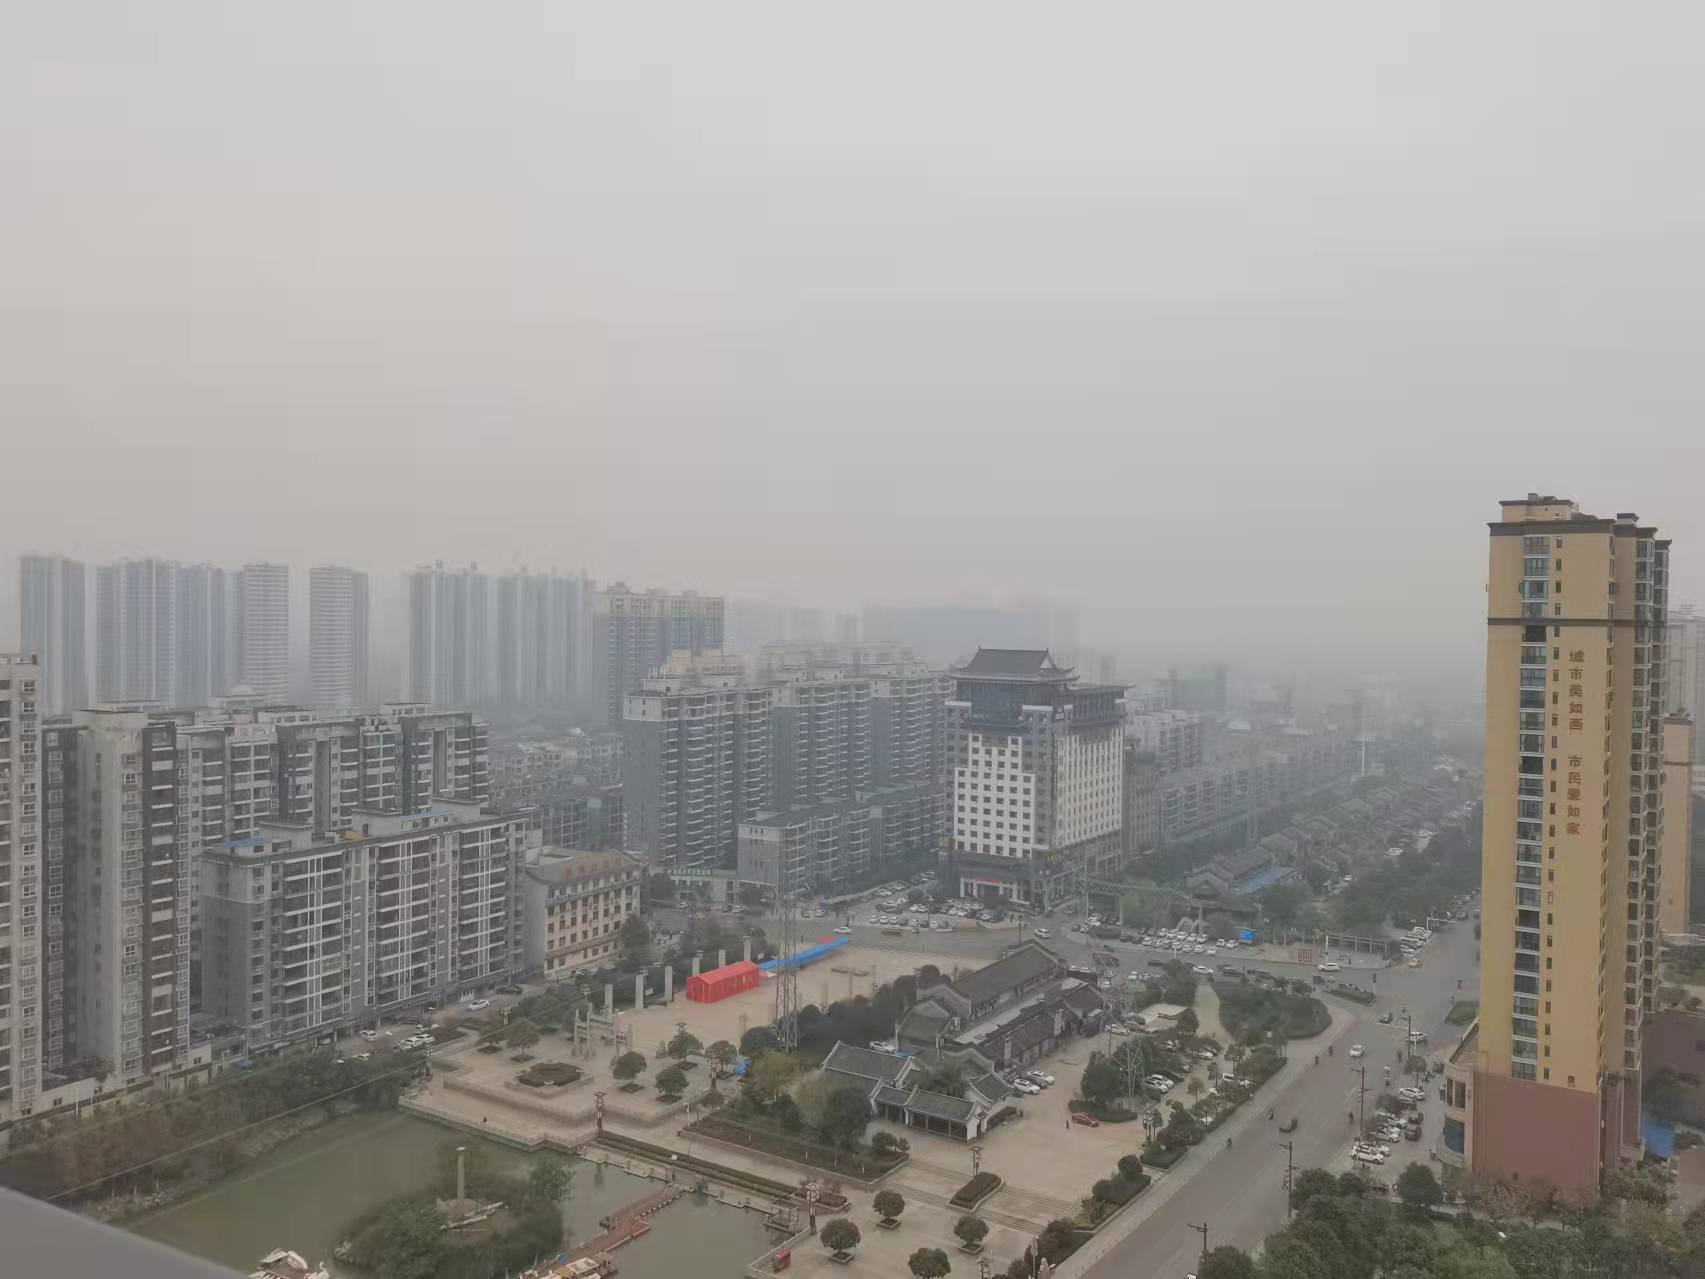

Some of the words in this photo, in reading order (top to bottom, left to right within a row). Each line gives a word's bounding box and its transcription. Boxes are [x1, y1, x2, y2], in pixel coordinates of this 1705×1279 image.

[1568, 650, 1584, 730] 城市美如画
[1567, 755, 1582, 835] 市民爱如家
